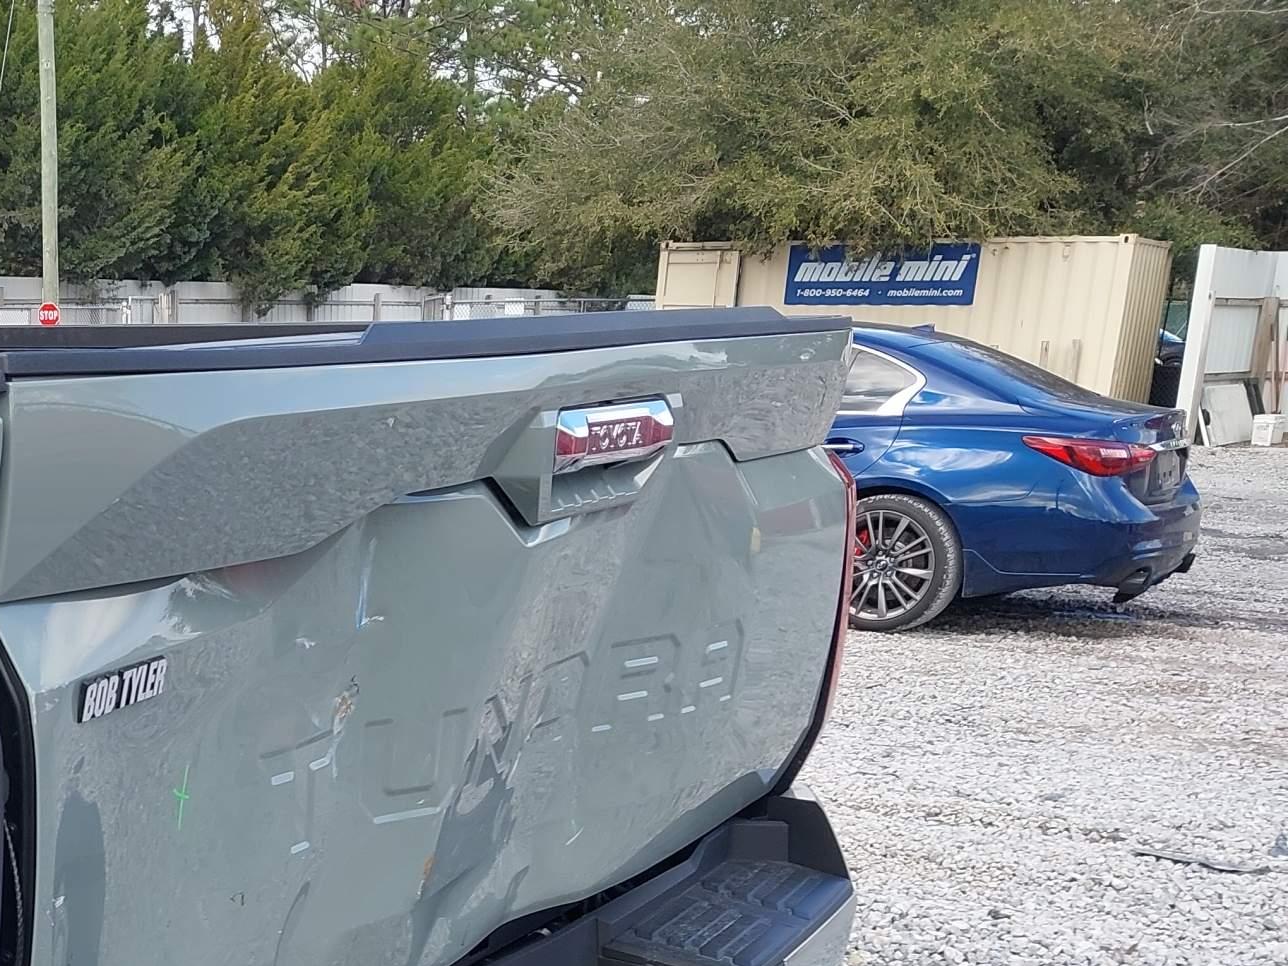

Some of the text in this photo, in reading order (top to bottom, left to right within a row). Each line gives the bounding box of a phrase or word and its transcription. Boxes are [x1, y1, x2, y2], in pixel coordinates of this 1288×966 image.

[793, 252, 972, 283] mobile mini
[796, 287, 963, 298] 1-800-950-6464 mobilemini.com
[39, 310, 59, 321] STOP
[590, 420, 644, 451] TOYOTA
[81, 658, 168, 722] BOB TYLER
